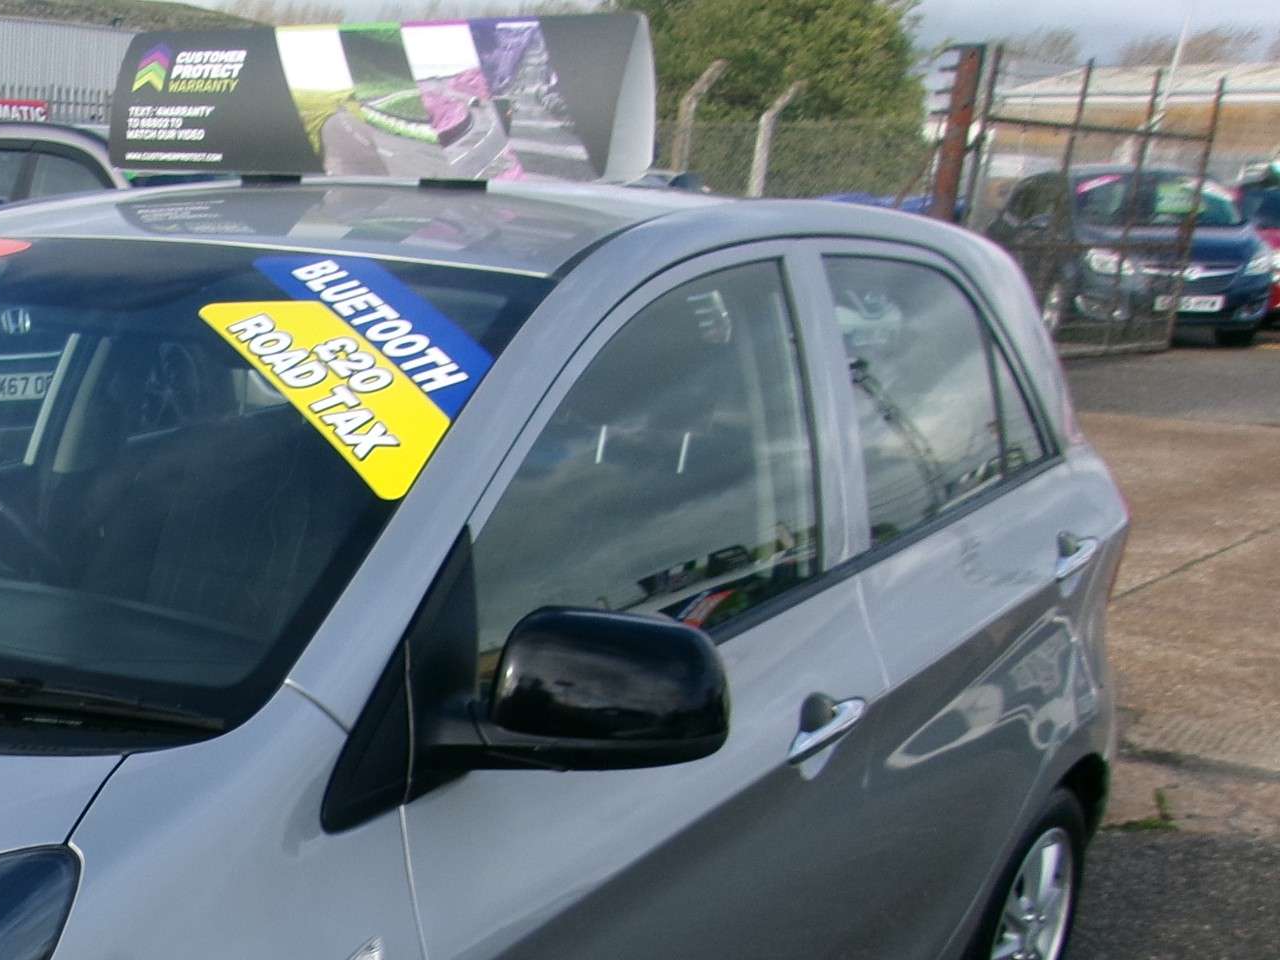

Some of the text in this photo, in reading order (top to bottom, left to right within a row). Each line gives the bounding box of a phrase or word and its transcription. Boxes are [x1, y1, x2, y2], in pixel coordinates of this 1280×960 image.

[175, 49, 248, 65] CUSTOMER
[170, 63, 244, 80] PROTECT
[168, 79, 239, 93] WARRANTY
[127, 118, 140, 129] TO
[170, 118, 183, 129] TO
[126, 129, 205, 141] WATCH OUR VIDEO
[291, 259, 469, 393] BLUETOOTH
[313, 336, 394, 394] £20
[227, 313, 401, 462] ROAD TAX
